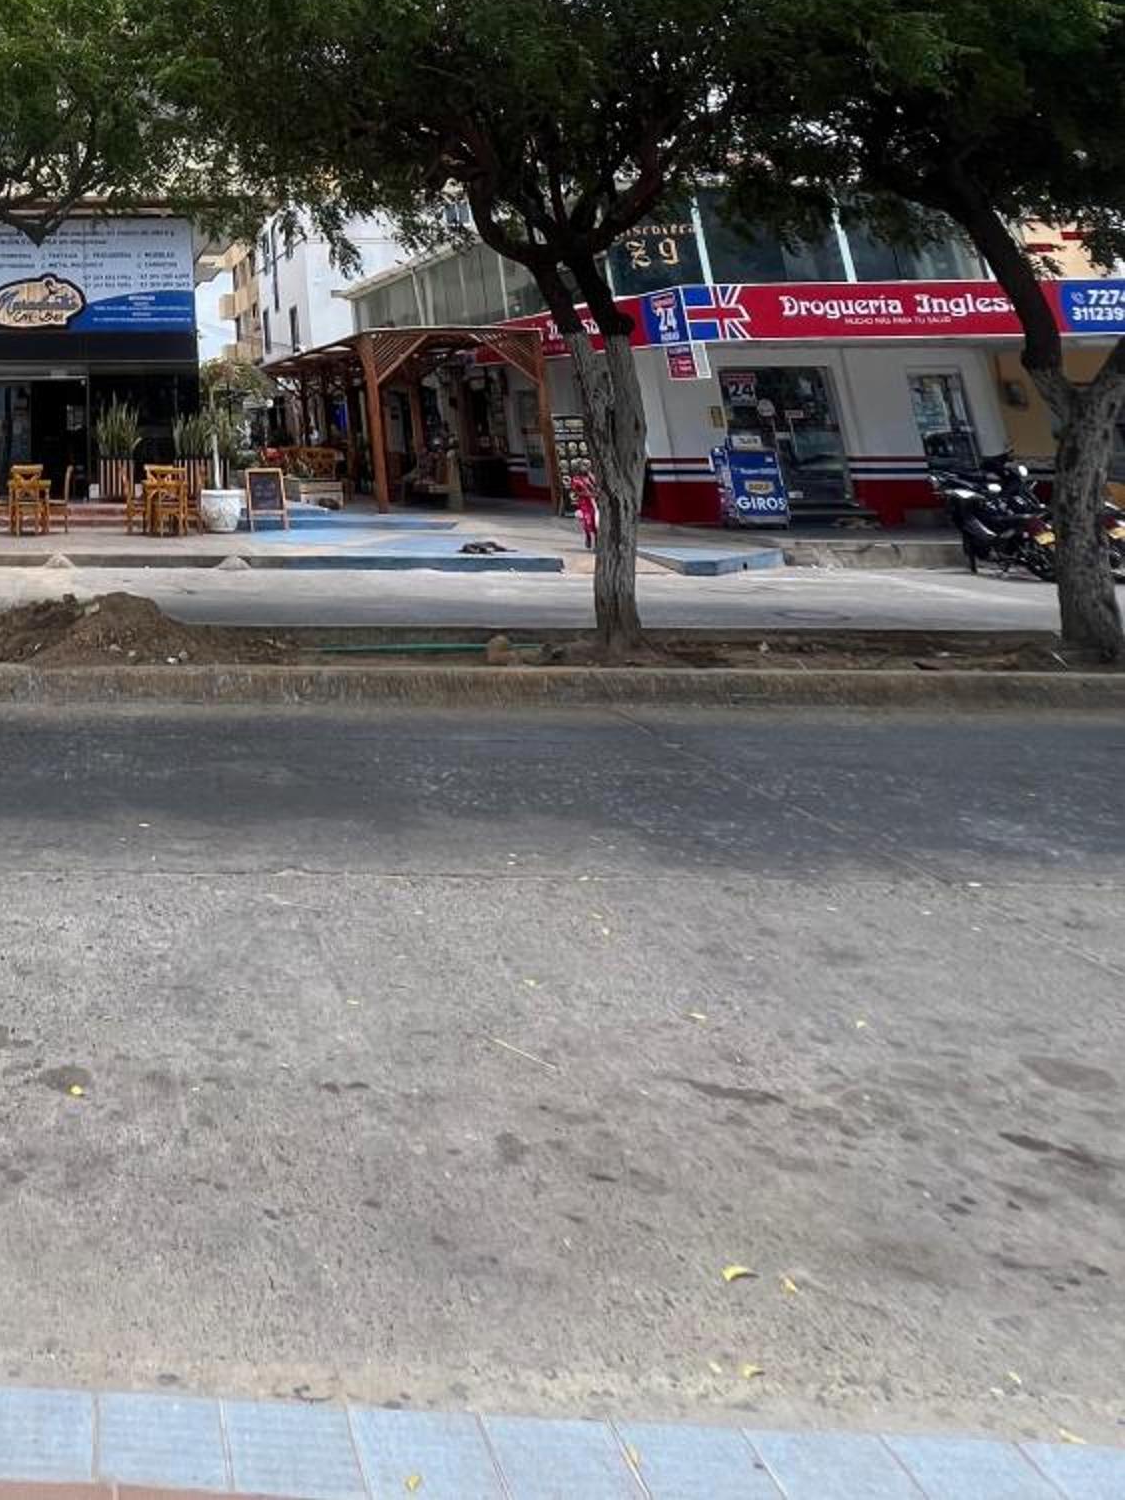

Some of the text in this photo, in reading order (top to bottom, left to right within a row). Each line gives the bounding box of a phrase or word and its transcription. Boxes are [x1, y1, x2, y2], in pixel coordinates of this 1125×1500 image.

[913, 293, 1016, 318] Ingles
[729, 382, 755, 397] 24
[736, 496, 788, 510] GIROS
